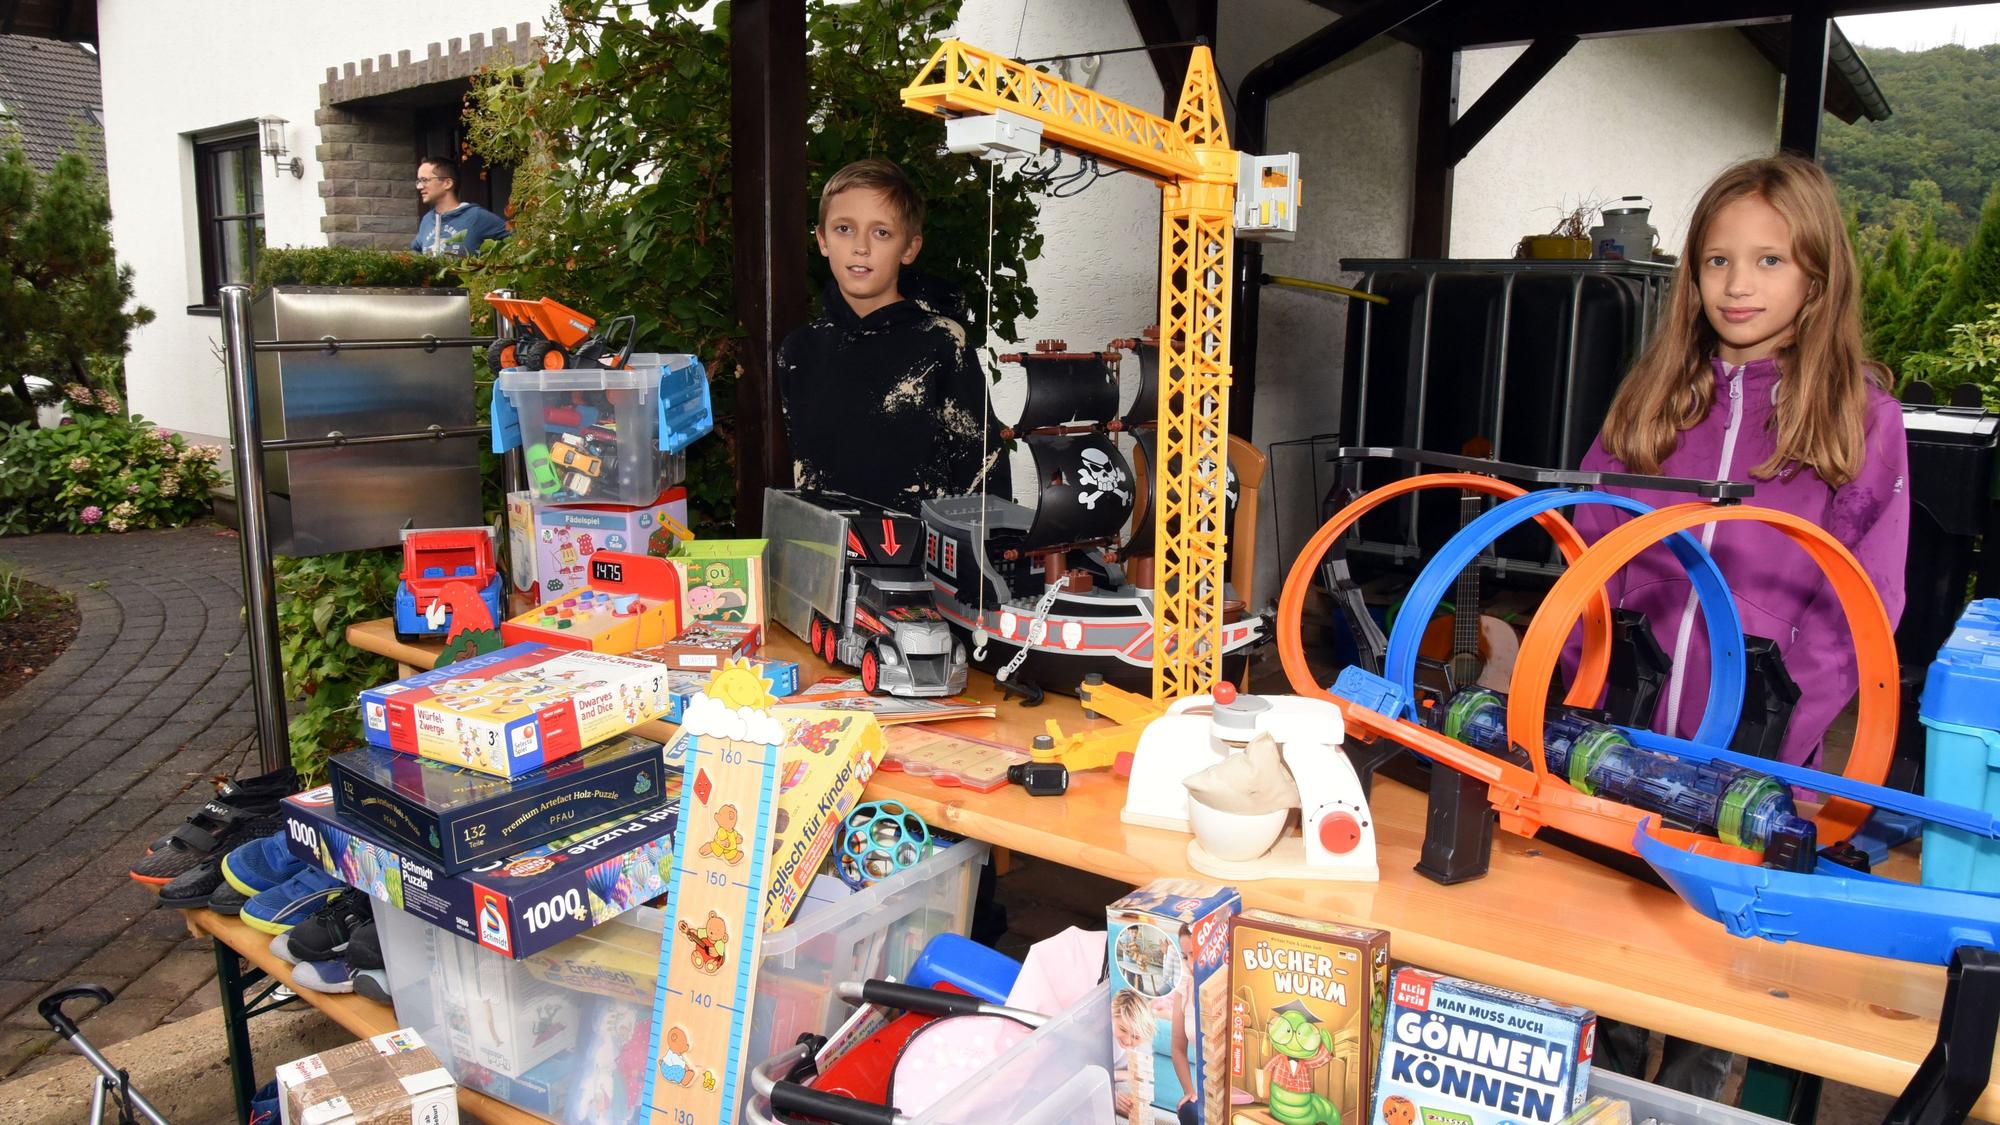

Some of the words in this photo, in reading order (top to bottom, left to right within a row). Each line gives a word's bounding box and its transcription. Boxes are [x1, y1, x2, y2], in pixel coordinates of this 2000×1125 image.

[565, 515, 600, 526] Fädelspiel
[609, 541, 622, 550] Teile
[596, 563, 621, 581] 14.75
[406, 655, 506, 687] Selecta
[579, 691, 613, 711] Dwarves
[418, 709, 445, 723] Würfel-
[581, 709, 597, 720] and
[597, 702, 614, 716] Dice
[419, 723, 445, 736] Zwerge
[514, 738, 533, 749] Selecta
[515, 747, 528, 755] Spiel
[719, 749, 742, 766] 160
[803, 813, 823, 841] für
[817, 761, 853, 817] Kinder
[501, 807, 540, 837] Premium
[540, 794, 572, 811] Artefact
[573, 789, 619, 800] Holz-Puzzle
[549, 810, 575, 825] PFAU
[287, 817, 317, 849] 1000
[463, 823, 487, 842] 132
[567, 821, 647, 855] Puzzle
[469, 839, 484, 848] Teile
[401, 856, 434, 881] Schmidt
[402, 870, 428, 891] Puzzle
[705, 870, 727, 887] 150
[523, 888, 581, 934] 1000
[482, 929, 508, 948] Schmidt
[1242, 940, 1349, 979] BÜCHER-
[565, 960, 636, 986] Englisch
[1273, 970, 1347, 1008] WURM
[690, 990, 712, 1008] 140
[1436, 997, 1467, 1014] MAN
[1468, 1005, 1505, 1024] MUSS
[1507, 1015, 1544, 1034] AUCH
[1396, 1012, 1563, 1084] GÖNNEN
[1391, 1050, 1555, 1123] KÖNNEN
[425, 1115, 431, 1124] ab
[674, 1108, 693, 1125] 130
